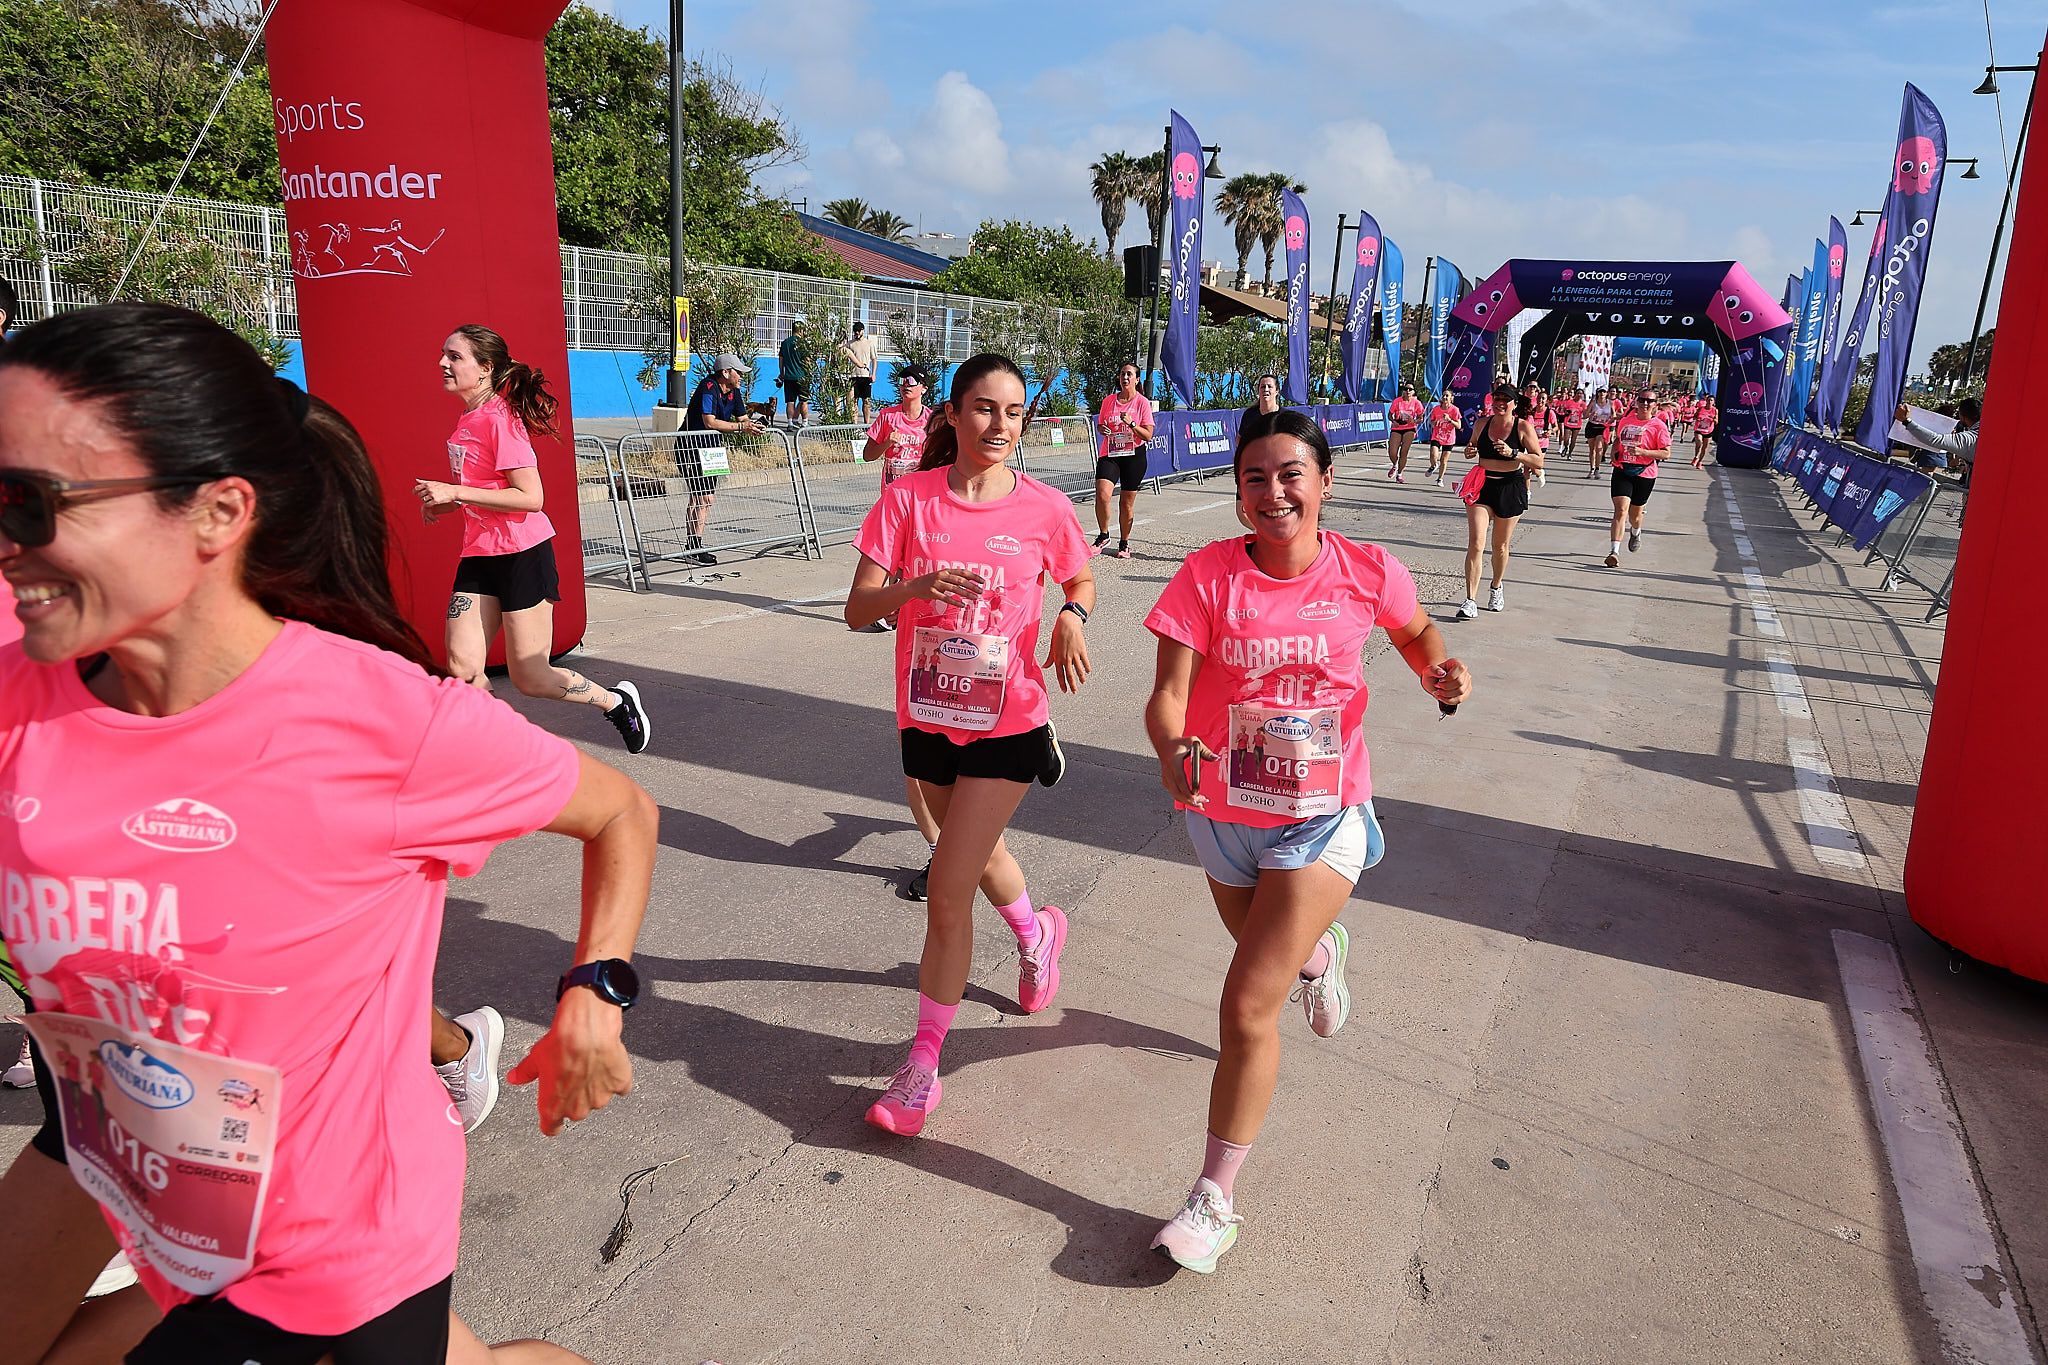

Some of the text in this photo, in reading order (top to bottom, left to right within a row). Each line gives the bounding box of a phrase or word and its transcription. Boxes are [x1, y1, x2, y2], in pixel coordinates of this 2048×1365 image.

[276, 95, 364, 143] Sports
[281, 164, 442, 201] Santander
[1577, 270, 1671, 285] octopus energy
[1552, 286, 1673, 297] LA ENERGÍA PARA CORRER
[1573, 296, 1624, 304] VELOCIDAD
[1586, 312, 1694, 326] VOLVO
[942, 643, 976, 656] ASTURIANA
[1221, 633, 1330, 668] CARRERA
[937, 673, 972, 693] 016
[1276, 673, 1314, 706] DE
[917, 697, 936, 705] CARRERA
[949, 702, 964, 710] MUJER
[967, 705, 991, 713] VALENCIA
[947, 693, 959, 702] 242
[917, 707, 989, 726] OYSHO Santander
[1240, 714, 1262, 722] SUMA
[1265, 757, 1309, 778] 016
[1240, 781, 1264, 791] CARRERA
[1265, 785, 1272, 793] DE
[1282, 789, 1302, 798] MUJER
[1276, 779, 1297, 788] 1776
[1240, 793, 1327, 812] OYSHO Santander
[131, 813, 226, 843] ASTURIANA
[108, 1117, 170, 1190] 016
[176, 1163, 257, 1186] CORREDORA
[160, 1222, 220, 1251] VALENCIA
